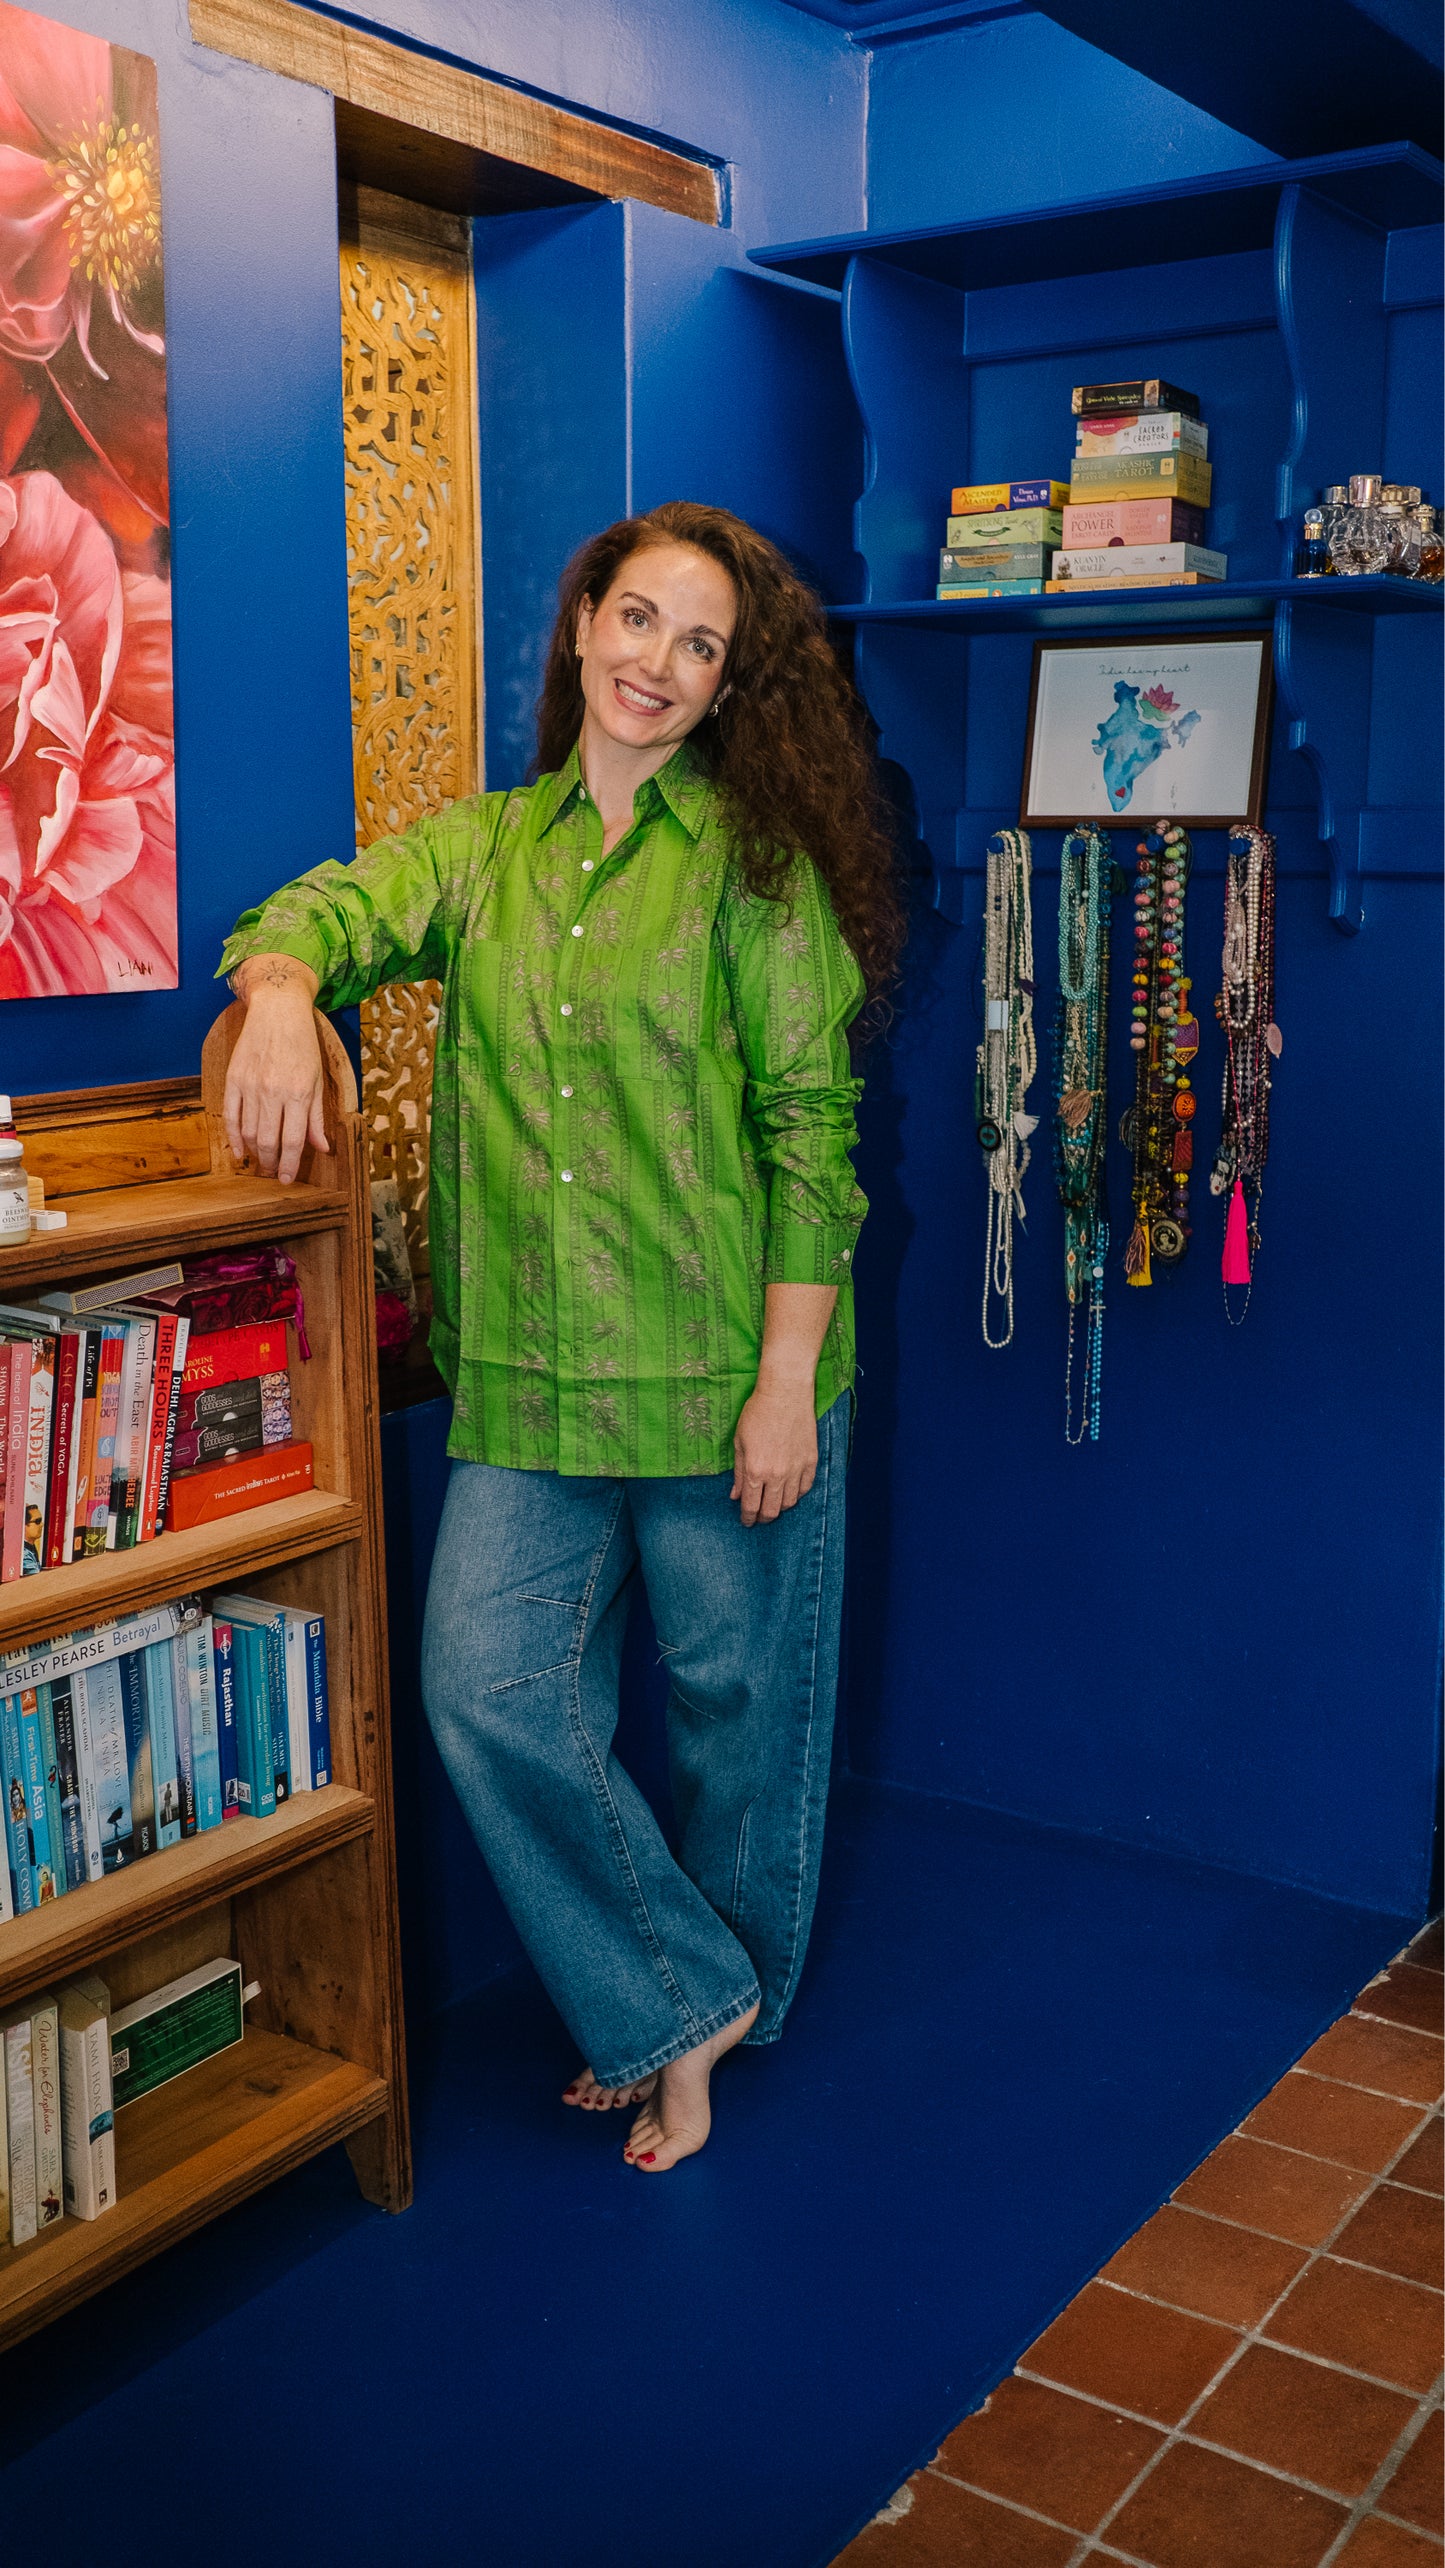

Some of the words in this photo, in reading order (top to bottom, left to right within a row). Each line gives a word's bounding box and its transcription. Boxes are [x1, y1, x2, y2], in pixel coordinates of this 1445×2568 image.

[1139, 426, 1165, 435] SACRED
[1115, 467, 1155, 477] TAROT
[1071, 519, 1114, 532] POWER
[1161, 664, 1190, 673] heart
[87, 1345, 95, 1363] Life
[136, 1325, 151, 1366] Death
[158, 1324, 174, 1374] THREE
[14, 1353, 23, 1369] The
[86, 1366, 93, 1378] of
[135, 1369, 142, 1379] in
[182, 1364, 214, 1383] MYSS
[184, 1355, 214, 1368] AROLINE
[14, 1373, 23, 1393] Idea
[85, 1378, 92, 1388] Pi
[133, 1381, 142, 1396] the
[170, 1376, 182, 1409] DELHI,
[13, 1395, 21, 1405] of
[131, 1400, 145, 1429] East
[152, 1380, 168, 1439] HOURS
[12, 1410, 25, 1450] India
[60, 1402, 69, 1434] Secrets
[166, 1411, 176, 1440] AGRA
[59, 1436, 66, 1446] of
[130, 1435, 140, 1454] ABIR
[164, 1442, 173, 1450] &
[58, 1448, 66, 1476] YOGA
[150, 1445, 162, 1485] Rosamund
[157, 1452, 172, 1510] RAJASTHAN
[148, 1486, 158, 1512] Lupton
[0, 1659, 48, 1690] LESLEY
[52, 1640, 106, 1670] PEARSE
[112, 1617, 161, 1646] Betrayal
[197, 1634, 206, 1651] TIM
[198, 1652, 208, 1686] WINTON
[312, 1650, 322, 1694] Mandala
[178, 1666, 188, 1705] COELHO
[200, 1688, 210, 1706] DIRT
[221, 1667, 234, 1728] Rajasthan
[42, 1686, 51, 1733] OHAMMED
[97, 1680, 106, 1726] INDRA
[108, 1686, 117, 1723] DEATH
[314, 1696, 324, 1724] Bible
[57, 1711, 66, 1745] FRATER
[63, 1699, 73, 1752] ALEXANDER
[110, 1727, 118, 1737] of
[202, 1709, 211, 1736] MUSIC
[11, 1727, 20, 1758] SARAH
[27, 1727, 38, 1782] First-Time
[101, 1733, 110, 1776] SINHA
[66, 1774, 75, 1803] CHASING
[114, 1761, 122, 1788] LOVE
[32, 1786, 46, 1820] Asia
[184, 1773, 194, 1816] MOUNTAIN
[16, 1821, 27, 1864] HOLY
[70, 1821, 79, 1854] MONSOON
[20, 1868, 32, 1910] COW!
[38, 2020, 52, 2065] Water
[90, 2028, 98, 2068] TAMI
[38, 2066, 50, 2078] for
[38, 2080, 54, 2136] Elephants
[12, 2138, 22, 2166] SILK
[48, 2148, 57, 2174] SARA
